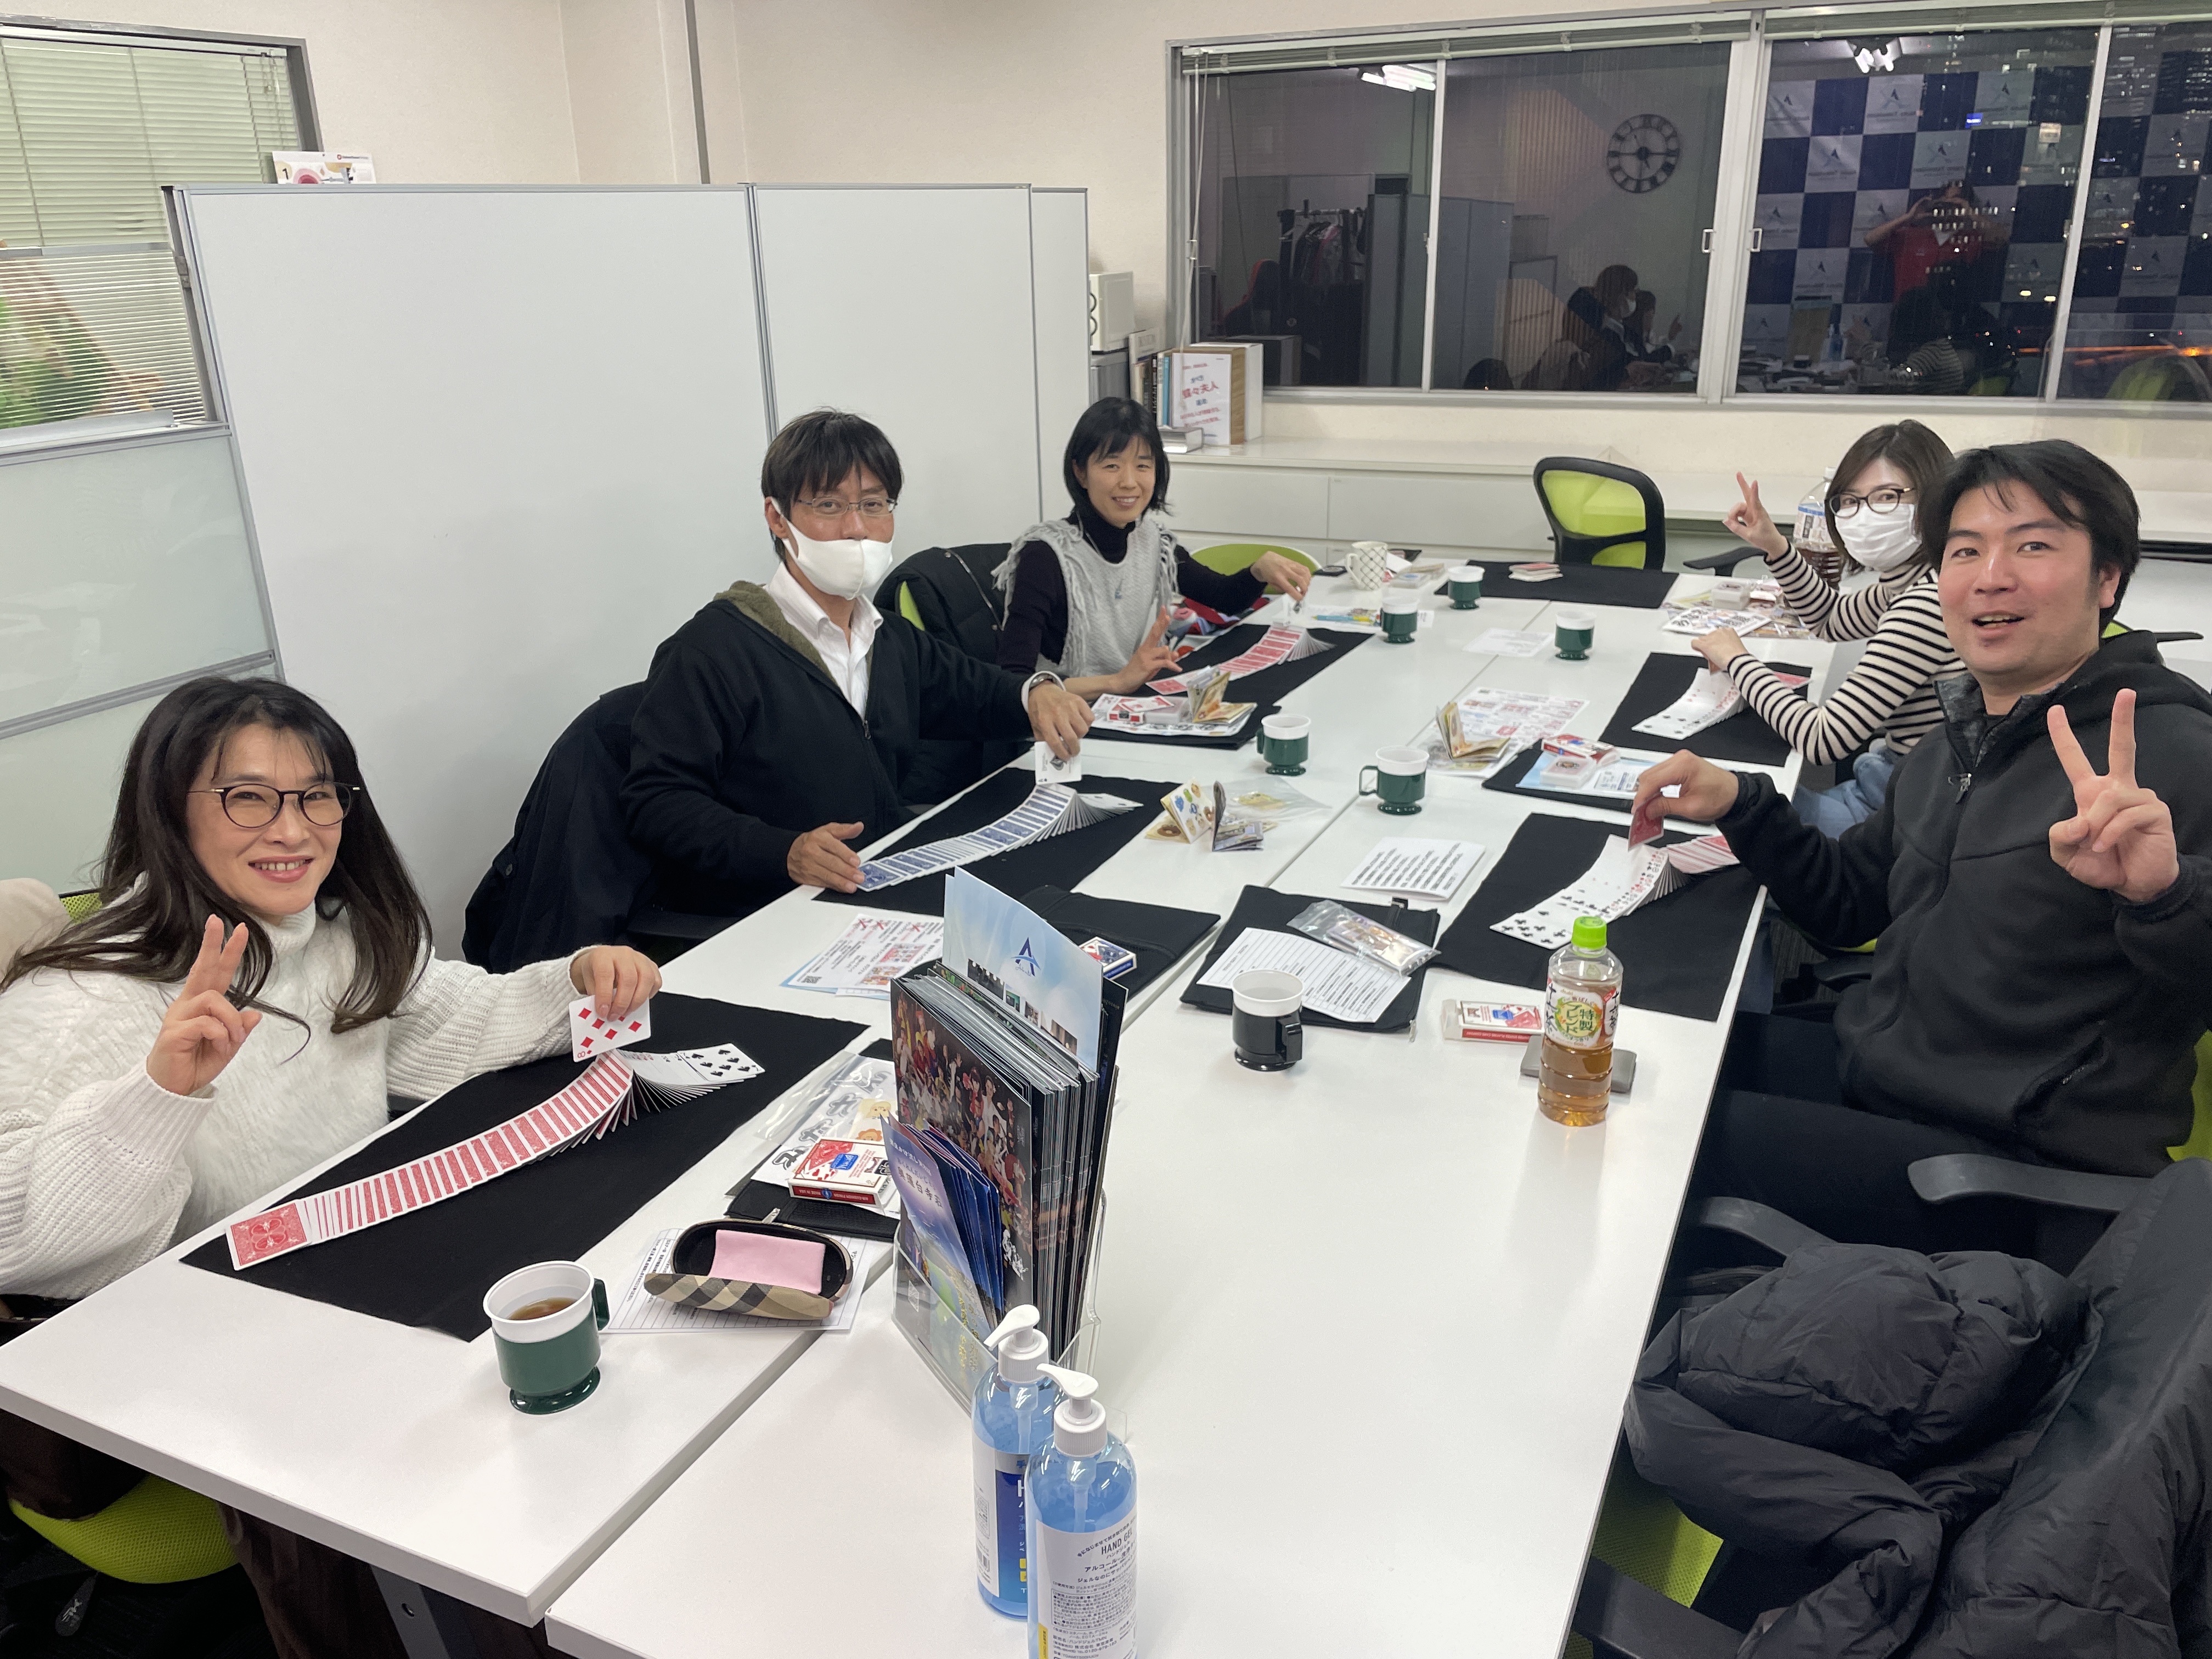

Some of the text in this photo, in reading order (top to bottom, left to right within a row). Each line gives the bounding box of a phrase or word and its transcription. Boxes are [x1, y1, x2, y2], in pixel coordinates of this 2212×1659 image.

[1566, 1003, 1582, 1034] ブレンド
[1579, 1008, 1595, 1031] 特製
[577, 1051, 586, 1059] 8
[1101, 1538, 1122, 1555] HAND
